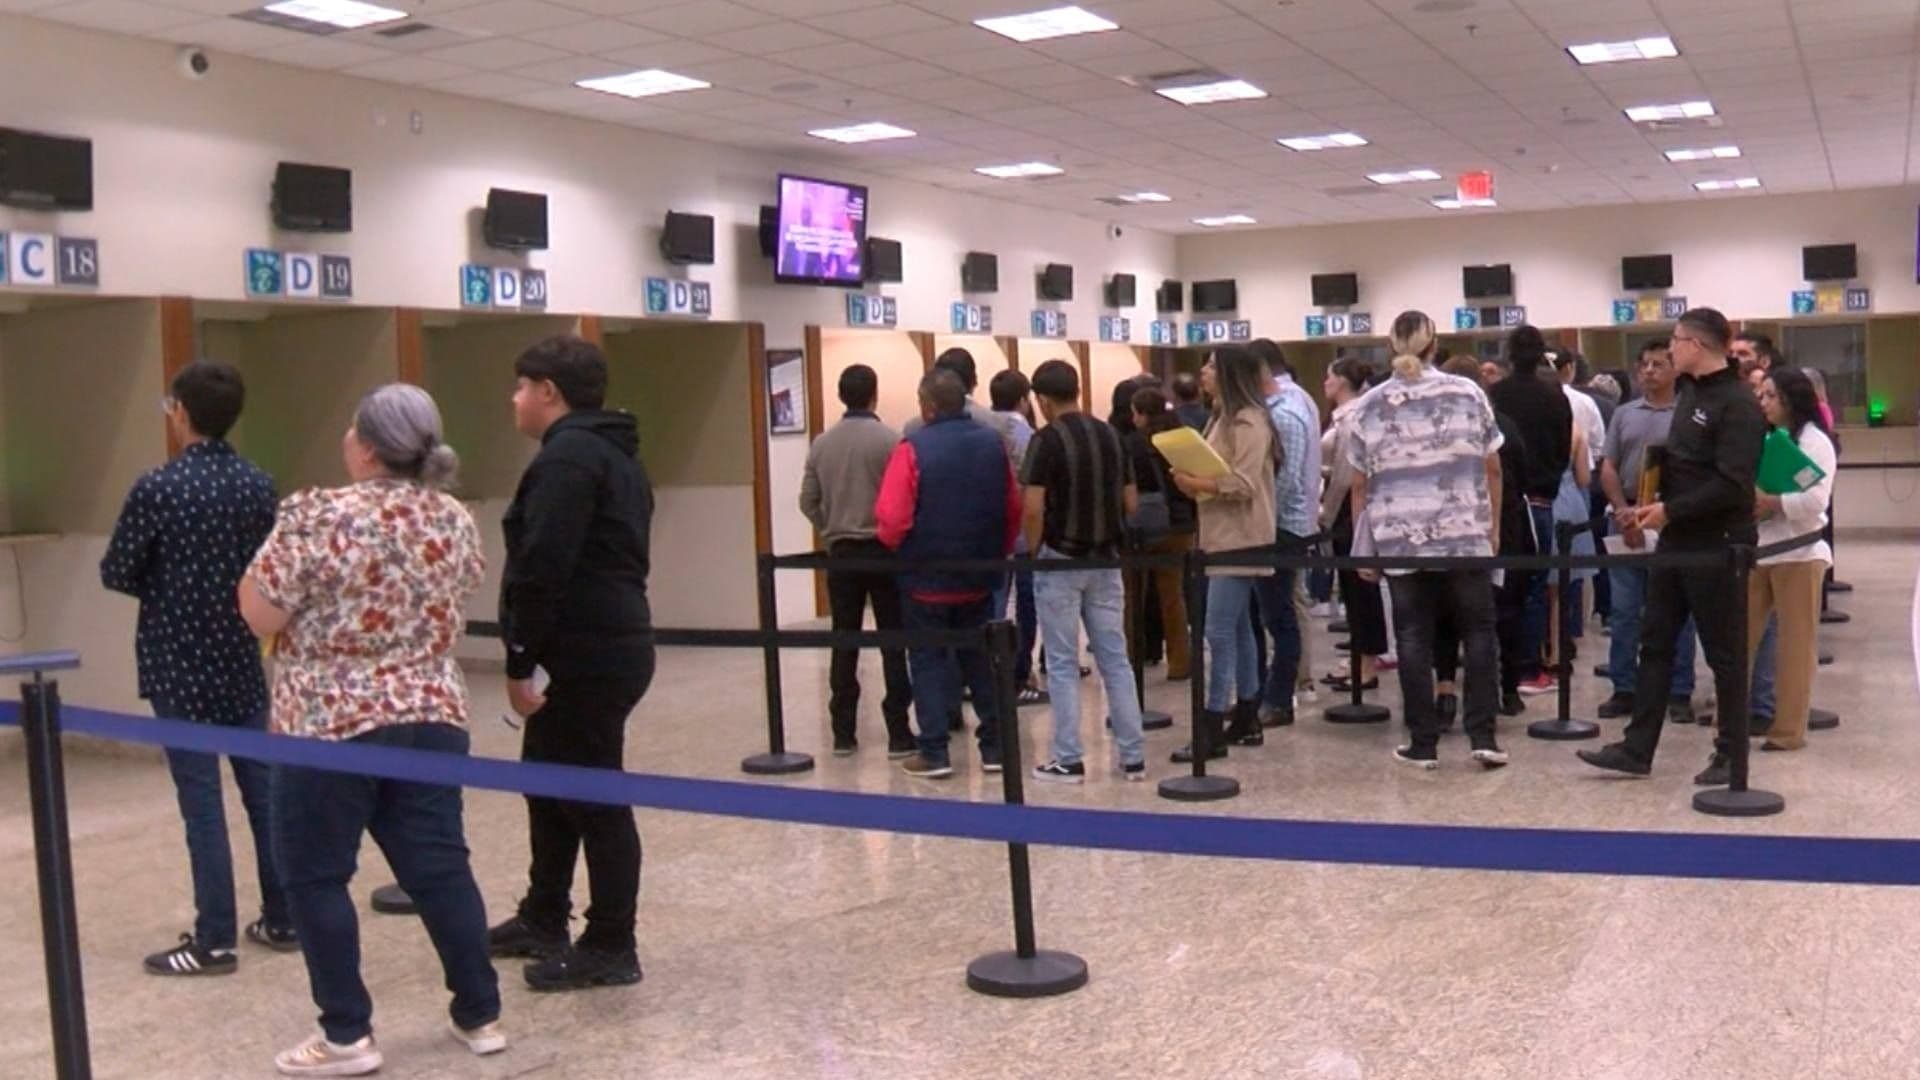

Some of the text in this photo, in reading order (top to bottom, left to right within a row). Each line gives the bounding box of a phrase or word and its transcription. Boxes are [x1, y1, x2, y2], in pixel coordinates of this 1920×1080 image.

[20, 239, 96, 278] C 18
[292, 257, 348, 291] D 19
[500, 271, 516, 300] D
[674, 282, 688, 308] D
[871, 298, 882, 321] D
[970, 306, 979, 327] D
[1213, 322, 1225, 338] D
[1331, 315, 1344, 333] D
